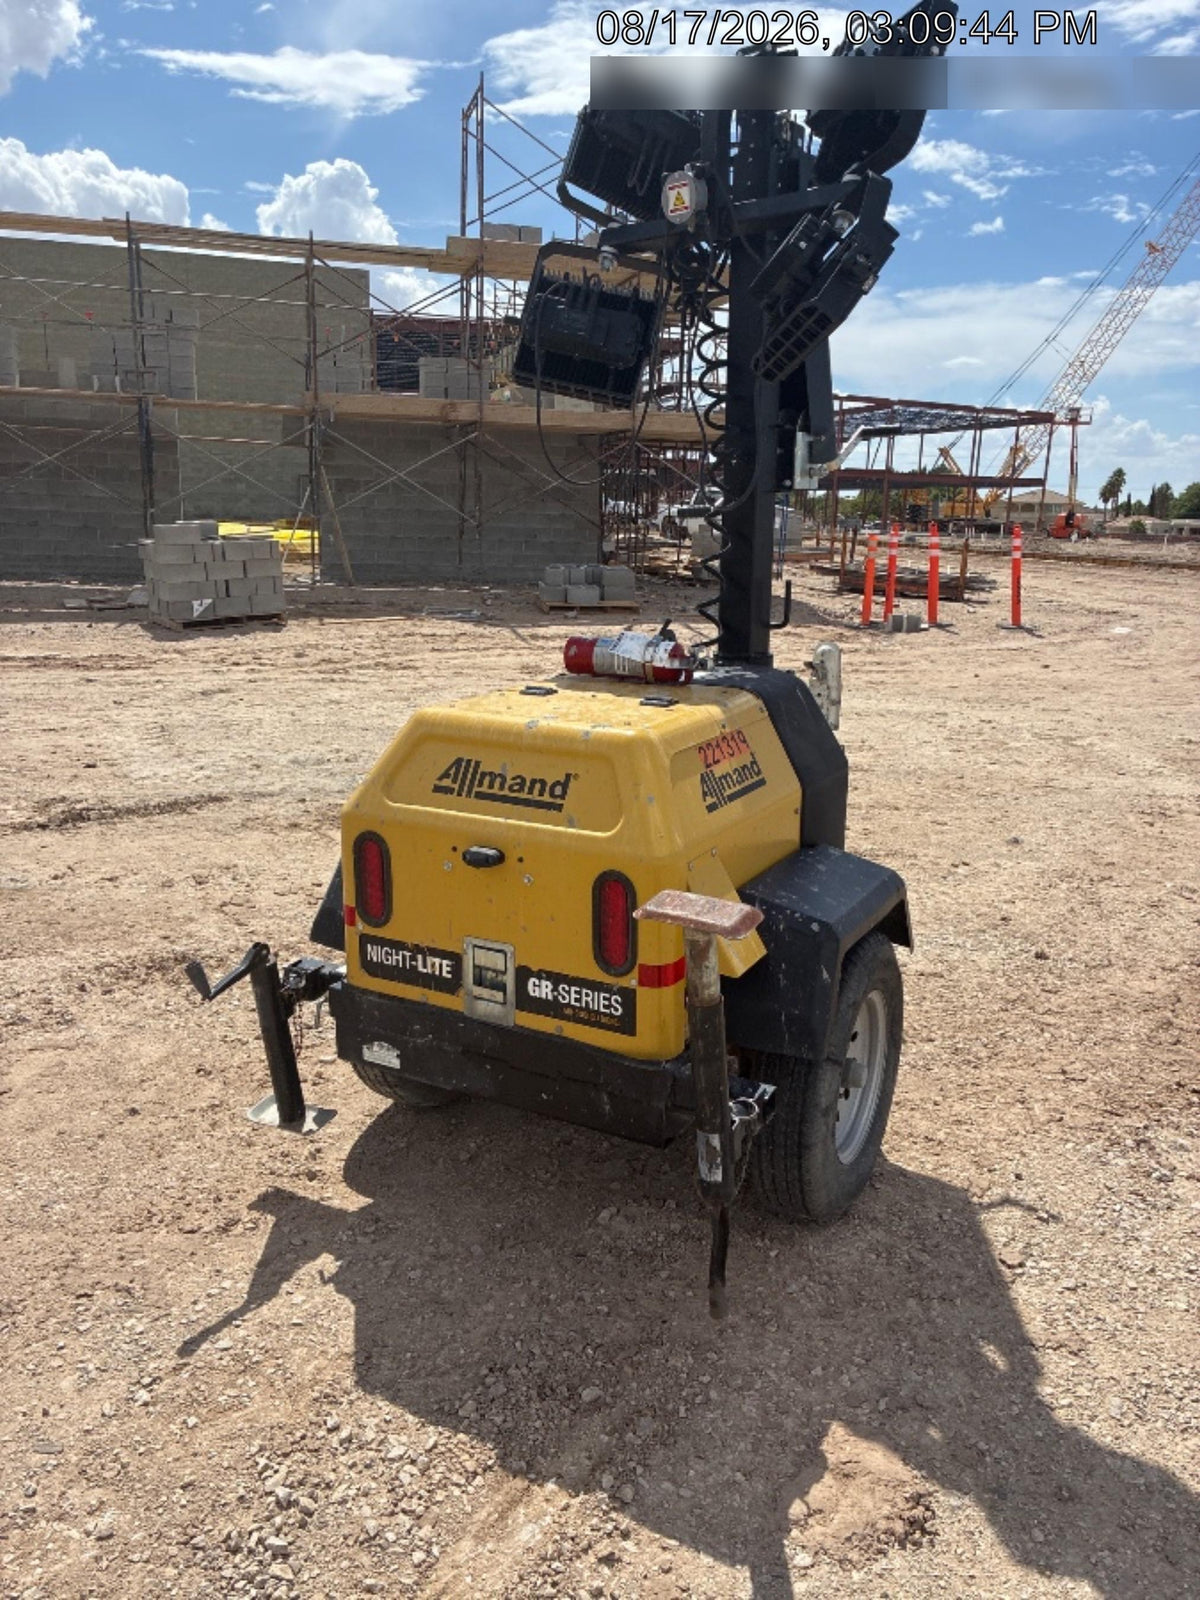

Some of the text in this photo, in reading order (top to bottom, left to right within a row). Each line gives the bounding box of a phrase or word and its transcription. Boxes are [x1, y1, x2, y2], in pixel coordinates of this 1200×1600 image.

[698, 730, 750, 768] 221319
[436, 757, 572, 801] Allmand
[700, 752, 762, 807] Allmand
[366, 943, 453, 979] NIGHT-LITE
[527, 977, 623, 1016] GR-SERIES
